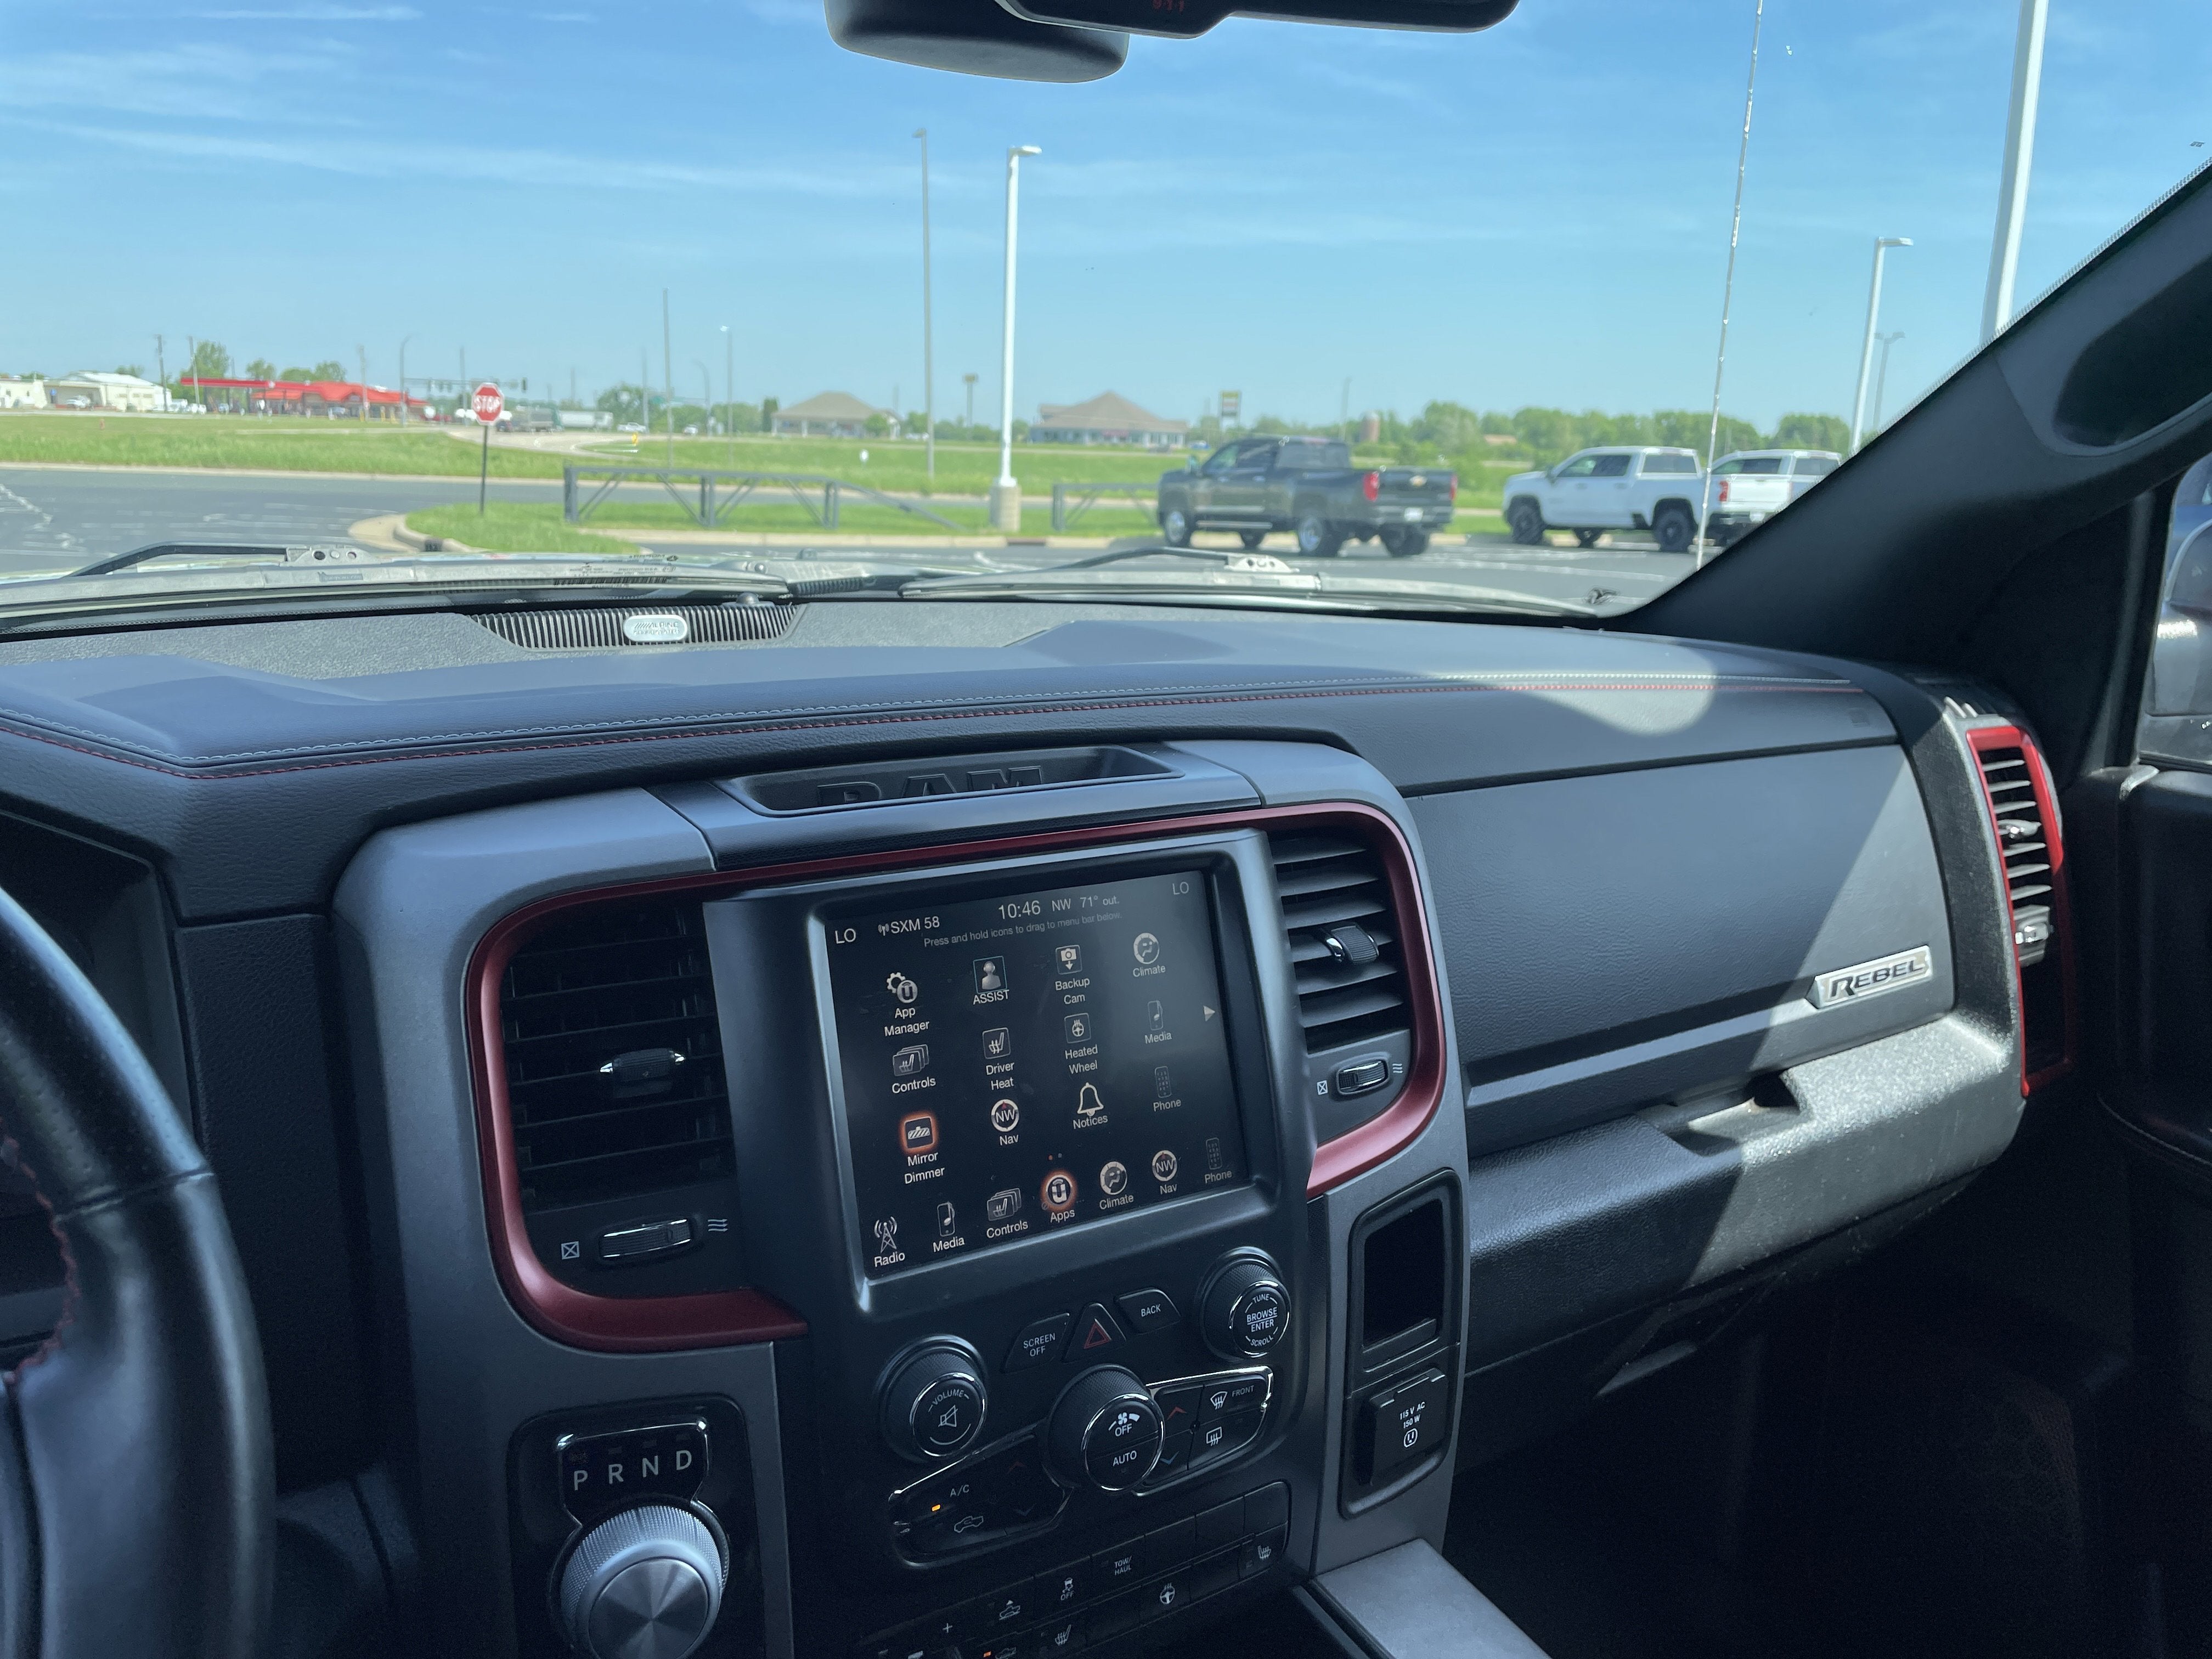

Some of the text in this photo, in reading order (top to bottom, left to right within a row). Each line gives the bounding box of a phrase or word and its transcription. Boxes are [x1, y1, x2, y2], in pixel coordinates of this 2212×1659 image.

[473, 396, 500, 413] STOP
[1172, 882, 1189, 895] LO
[998, 900, 1041, 919] 10:46
[1052, 898, 1071, 912] NW
[1080, 895, 1098, 908] 71°
[890, 916, 940, 933] SXM 58
[924, 912, 1122, 947] Press and hold icons to drag to menu bar below.
[834, 928, 856, 944] LO
[1132, 964, 1166, 978] Climate
[1055, 977, 1090, 991] Backup
[1831, 960, 1925, 997] REBEL
[973, 989, 1010, 1005] ASSIST
[1063, 994, 1085, 1005] Cam
[895, 1007, 916, 1020] App
[884, 1022, 930, 1036] Manager
[1144, 1031, 1172, 1044] Media
[1065, 1045, 1098, 1059] Heated
[986, 1062, 1014, 1075] Driver
[1069, 1060, 1098, 1074] Wheel
[891, 1076, 936, 1094] Controls
[991, 1077, 1014, 1090] Heat
[1153, 1098, 1182, 1111] Phone
[995, 1109, 1015, 1122] NW
[1073, 1115, 1108, 1129] Notices
[1000, 1134, 1019, 1146] Nav
[907, 1152, 939, 1167] Mirror
[1156, 1160, 1174, 1173] NW
[905, 1167, 945, 1184] Dimmer
[1204, 1170, 1232, 1183] Phone
[1160, 1184, 1177, 1194] Nav
[1099, 1194, 1134, 1210] Climate
[1050, 1209, 1075, 1223] Apps
[986, 1220, 1028, 1238] Controls
[933, 1236, 965, 1252] Media
[874, 1251, 905, 1267] Radio
[1252, 1294, 1270, 1304] TUNE
[1141, 1304, 1161, 1317] BACK
[1246, 1307, 1277, 1323] BROWSE
[1251, 1319, 1274, 1332] ENTER
[1023, 1333, 1056, 1348] SCREEN
[1250, 1335, 1273, 1346] SCROLL
[1030, 1346, 1046, 1357] OFF
[933, 1389, 964, 1405] VOLUME
[1232, 1385, 1255, 1397] FRONT
[1400, 1409, 1409, 1420] 115
[1417, 1402, 1425, 1411] AC
[1403, 1414, 1420, 1429] 150 W
[1115, 1423, 1132, 1437] OFF
[1113, 1450, 1137, 1466] AUTO
[573, 1450, 692, 1491] P R N D
[950, 1485, 969, 1497] A/C
[1114, 1555, 1132, 1568] TOW/
[1114, 1565, 1132, 1576] HAUL
[1060, 1590, 1074, 1601] OFF
